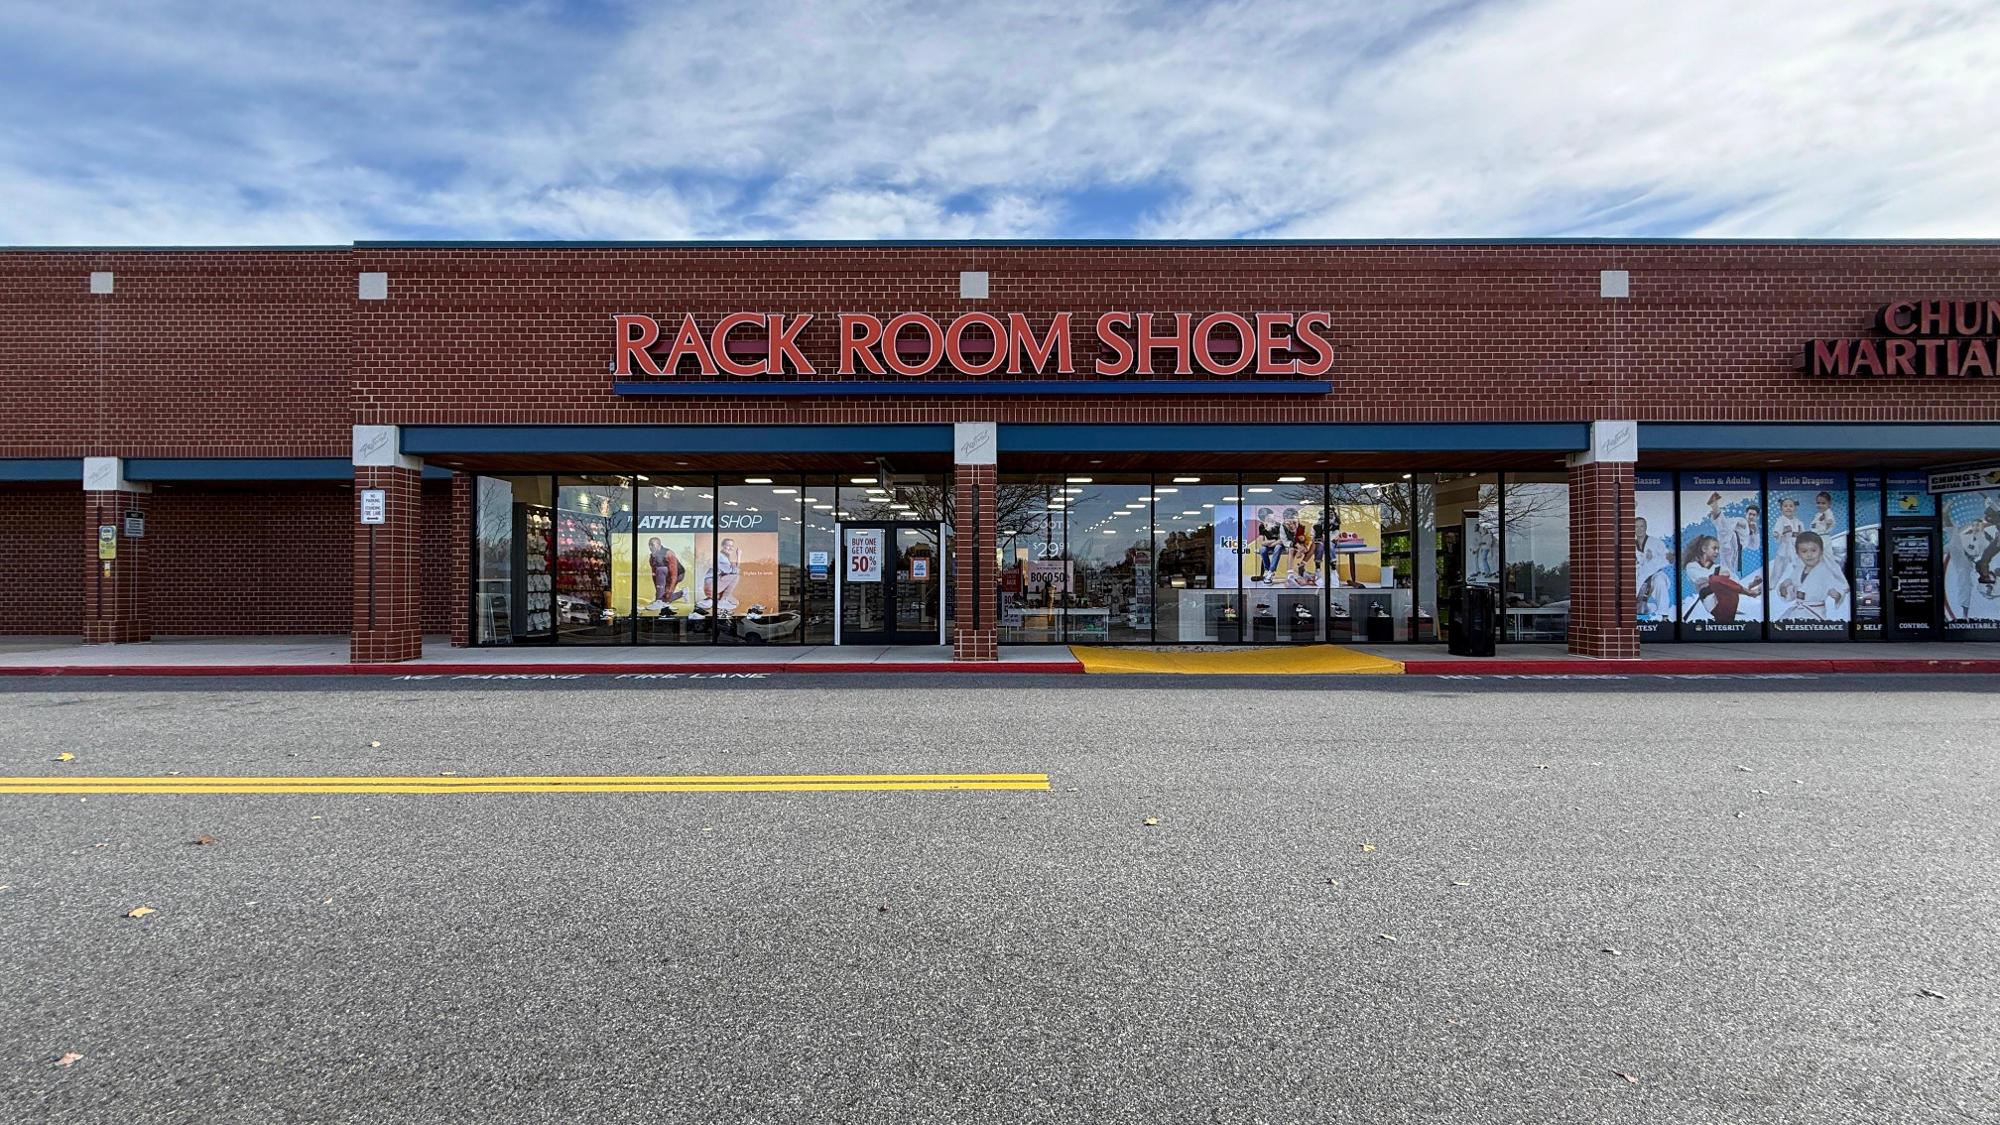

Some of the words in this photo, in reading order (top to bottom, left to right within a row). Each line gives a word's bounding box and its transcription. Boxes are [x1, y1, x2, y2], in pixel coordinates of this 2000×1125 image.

[613, 312, 816, 376] RACK
[837, 311, 1074, 376] ROOM
[1096, 311, 1334, 376] SHOES
[1813, 339, 2000, 376] MARTIA
[1726, 476, 1751, 484] Adults
[1802, 477, 1834, 485] Dragons
[638, 516, 714, 528] ATHLETIC
[720, 515, 762, 529] SHOP
[852, 538, 863, 546] BUY
[865, 538, 877, 546] ONE
